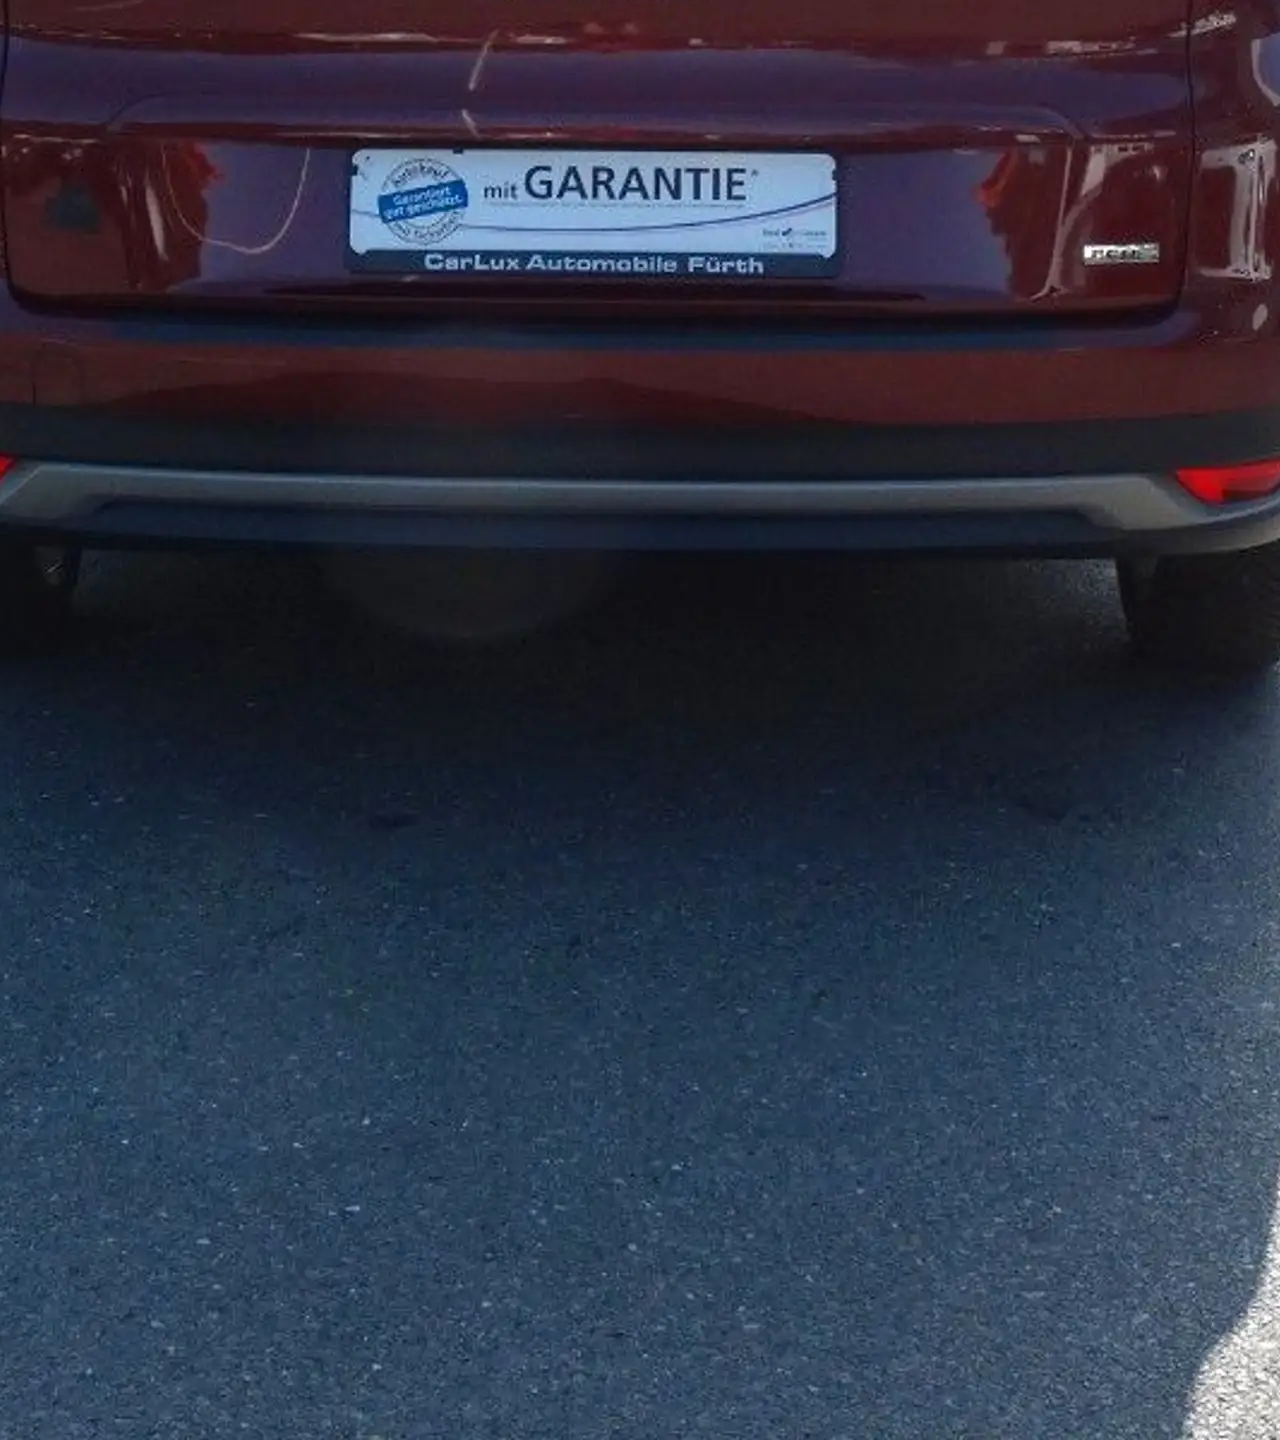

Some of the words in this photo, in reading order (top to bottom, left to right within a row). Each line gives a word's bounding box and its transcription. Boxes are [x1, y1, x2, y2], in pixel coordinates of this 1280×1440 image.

[483, 180, 518, 200] mit
[423, 253, 520, 271] CarLux
[524, 254, 677, 273] Automobile
[687, 256, 765, 274] Fürth
